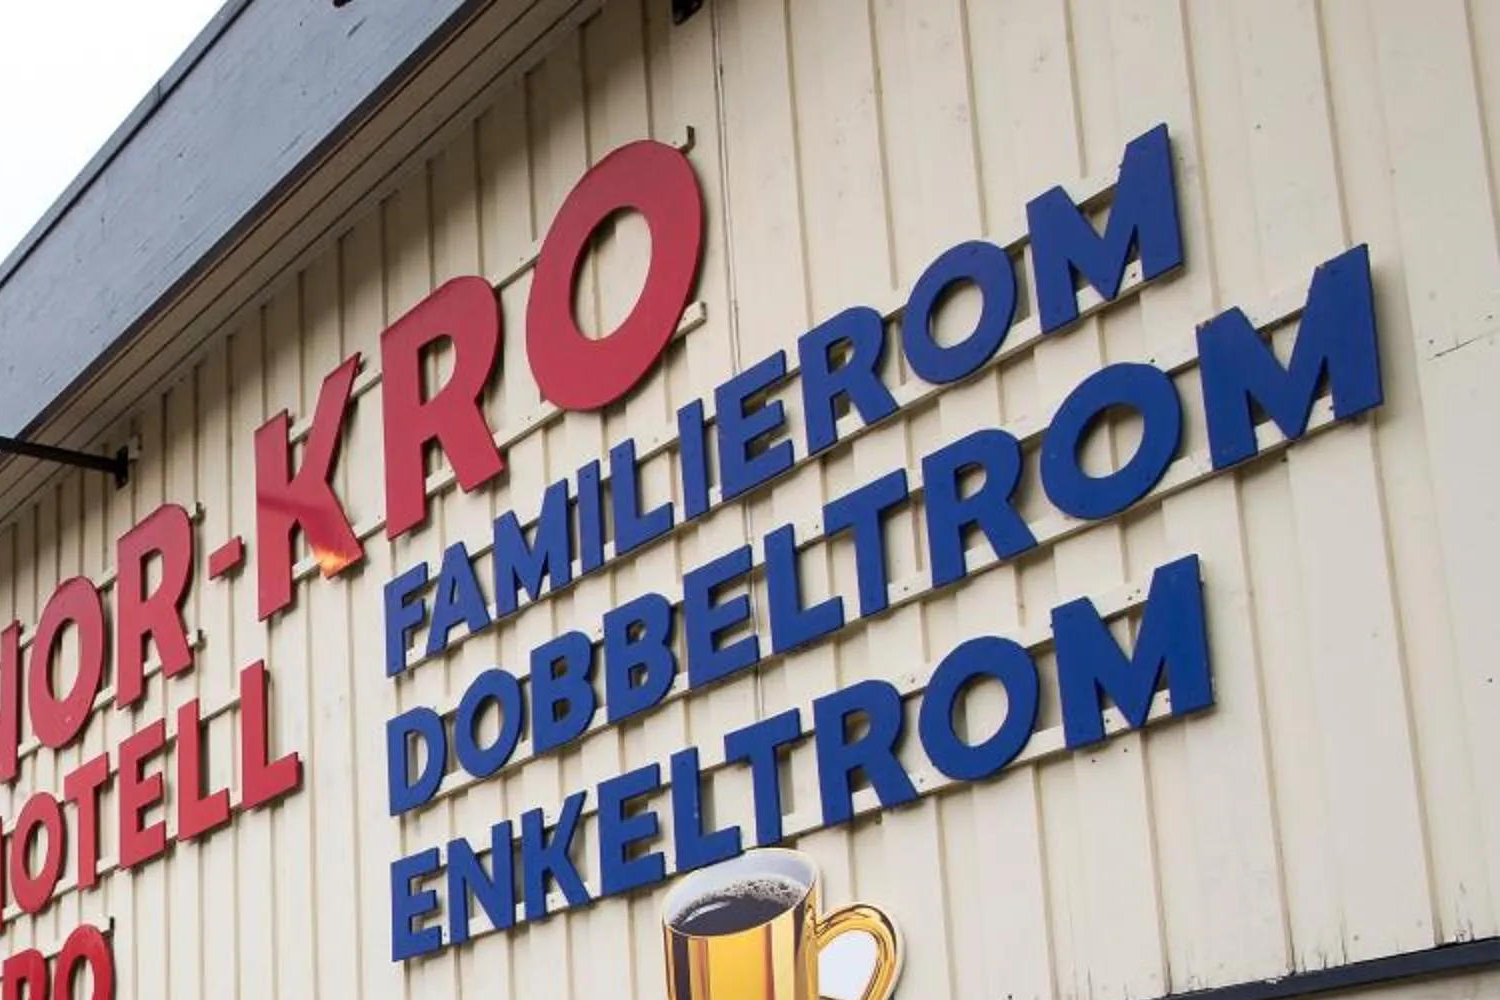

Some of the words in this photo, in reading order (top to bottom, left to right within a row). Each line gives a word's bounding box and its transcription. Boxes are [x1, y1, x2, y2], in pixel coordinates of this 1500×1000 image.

[382, 123, 1184, 676] FAMILIEROM
[386, 243, 1383, 816] DOBBELTROM
[390, 553, 1214, 962] ENKELTROM
